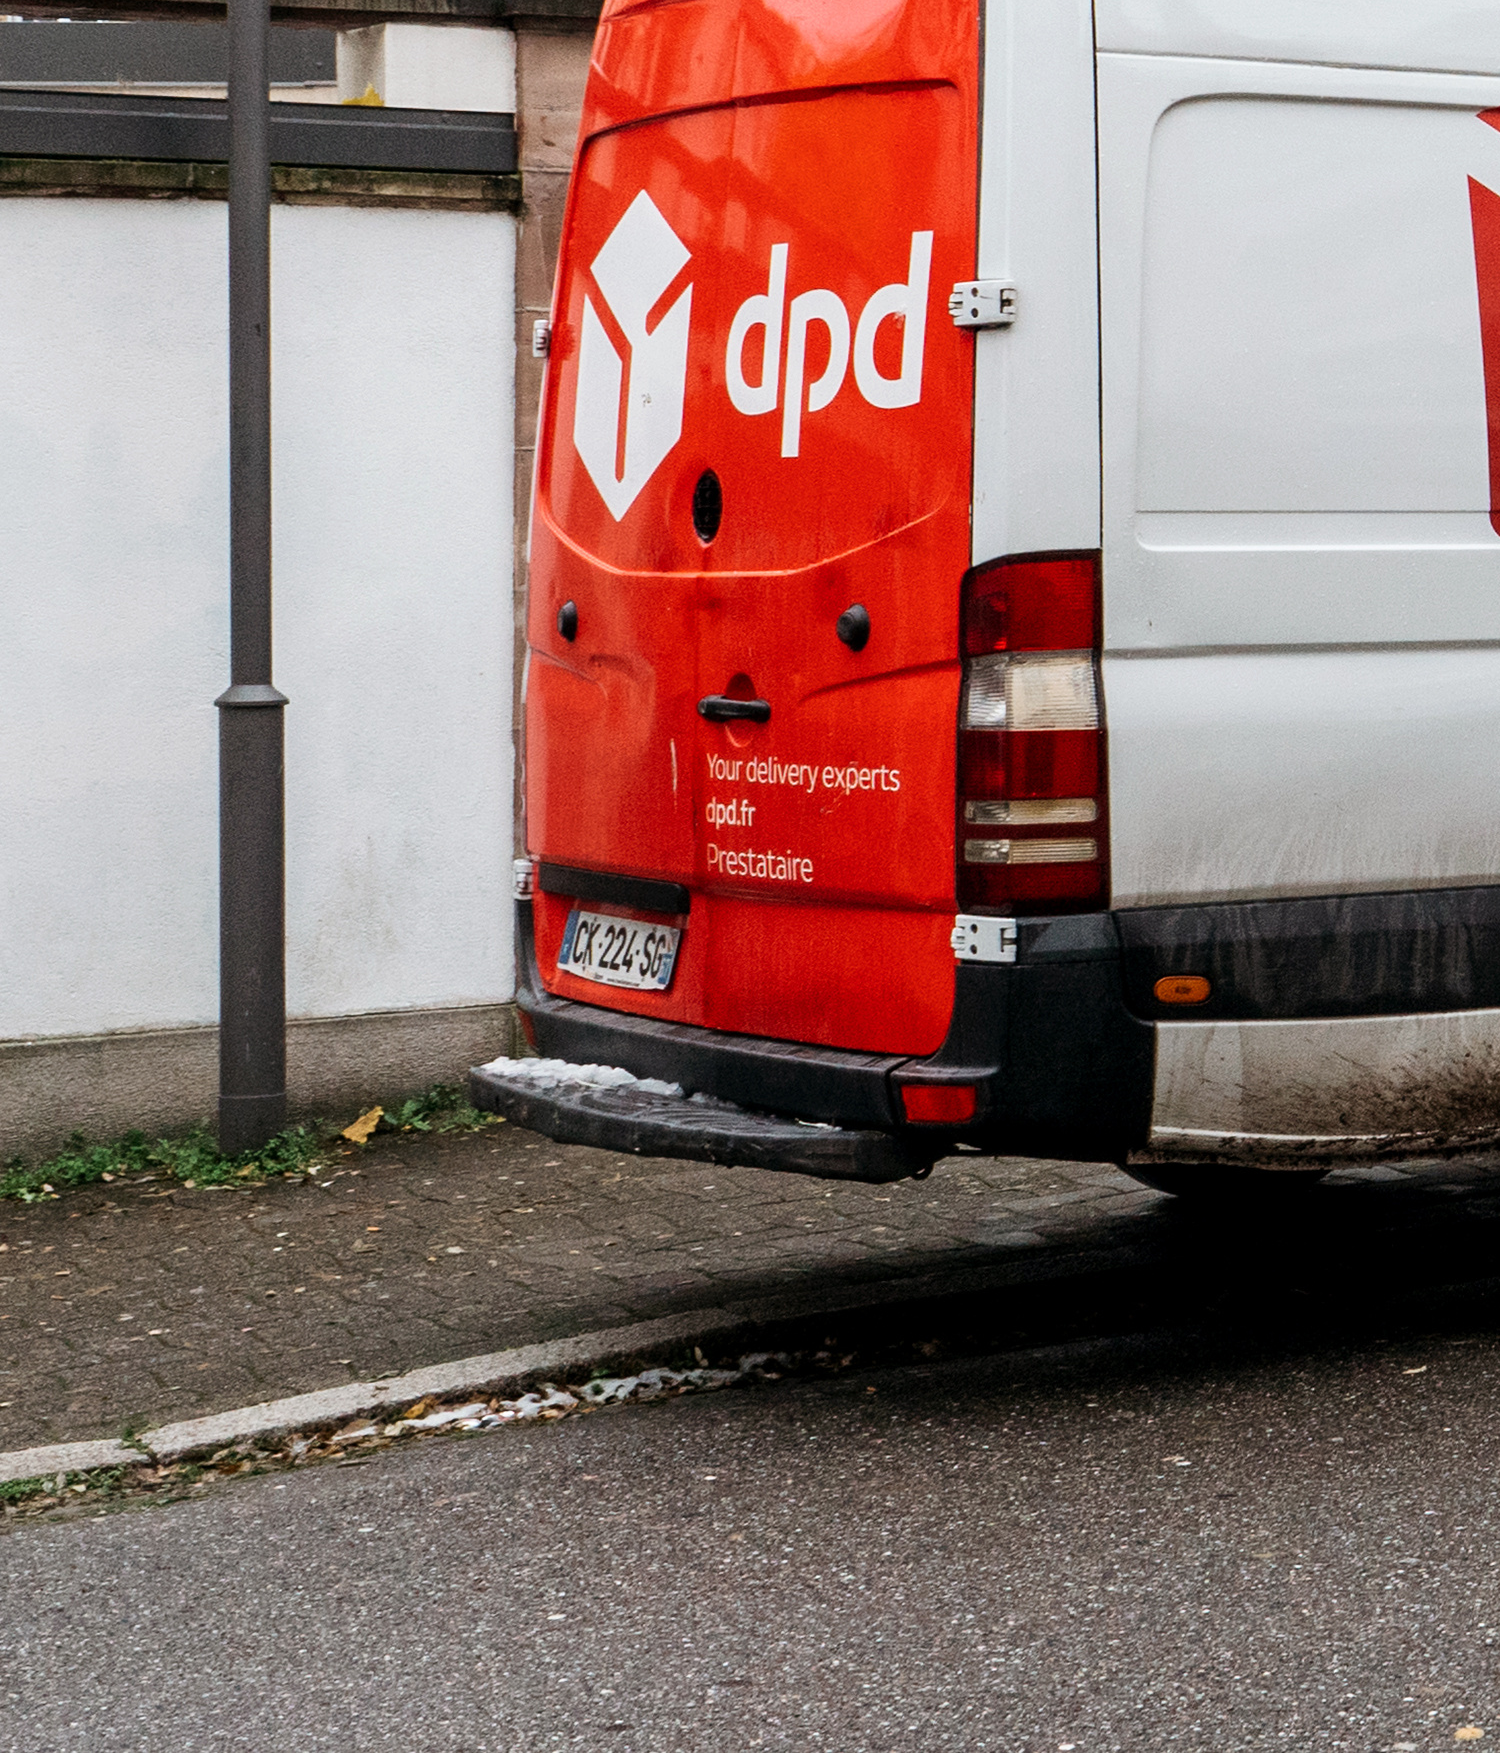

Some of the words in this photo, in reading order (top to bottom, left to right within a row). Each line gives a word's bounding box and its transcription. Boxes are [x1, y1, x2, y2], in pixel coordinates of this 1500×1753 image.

[724, 230, 934, 459] dpd
[706, 752, 744, 782] Your
[746, 756, 820, 794] delivery
[821, 764, 901, 796] experts
[705, 796, 757, 831] dpd.fr
[706, 843, 814, 883] Prestataire
